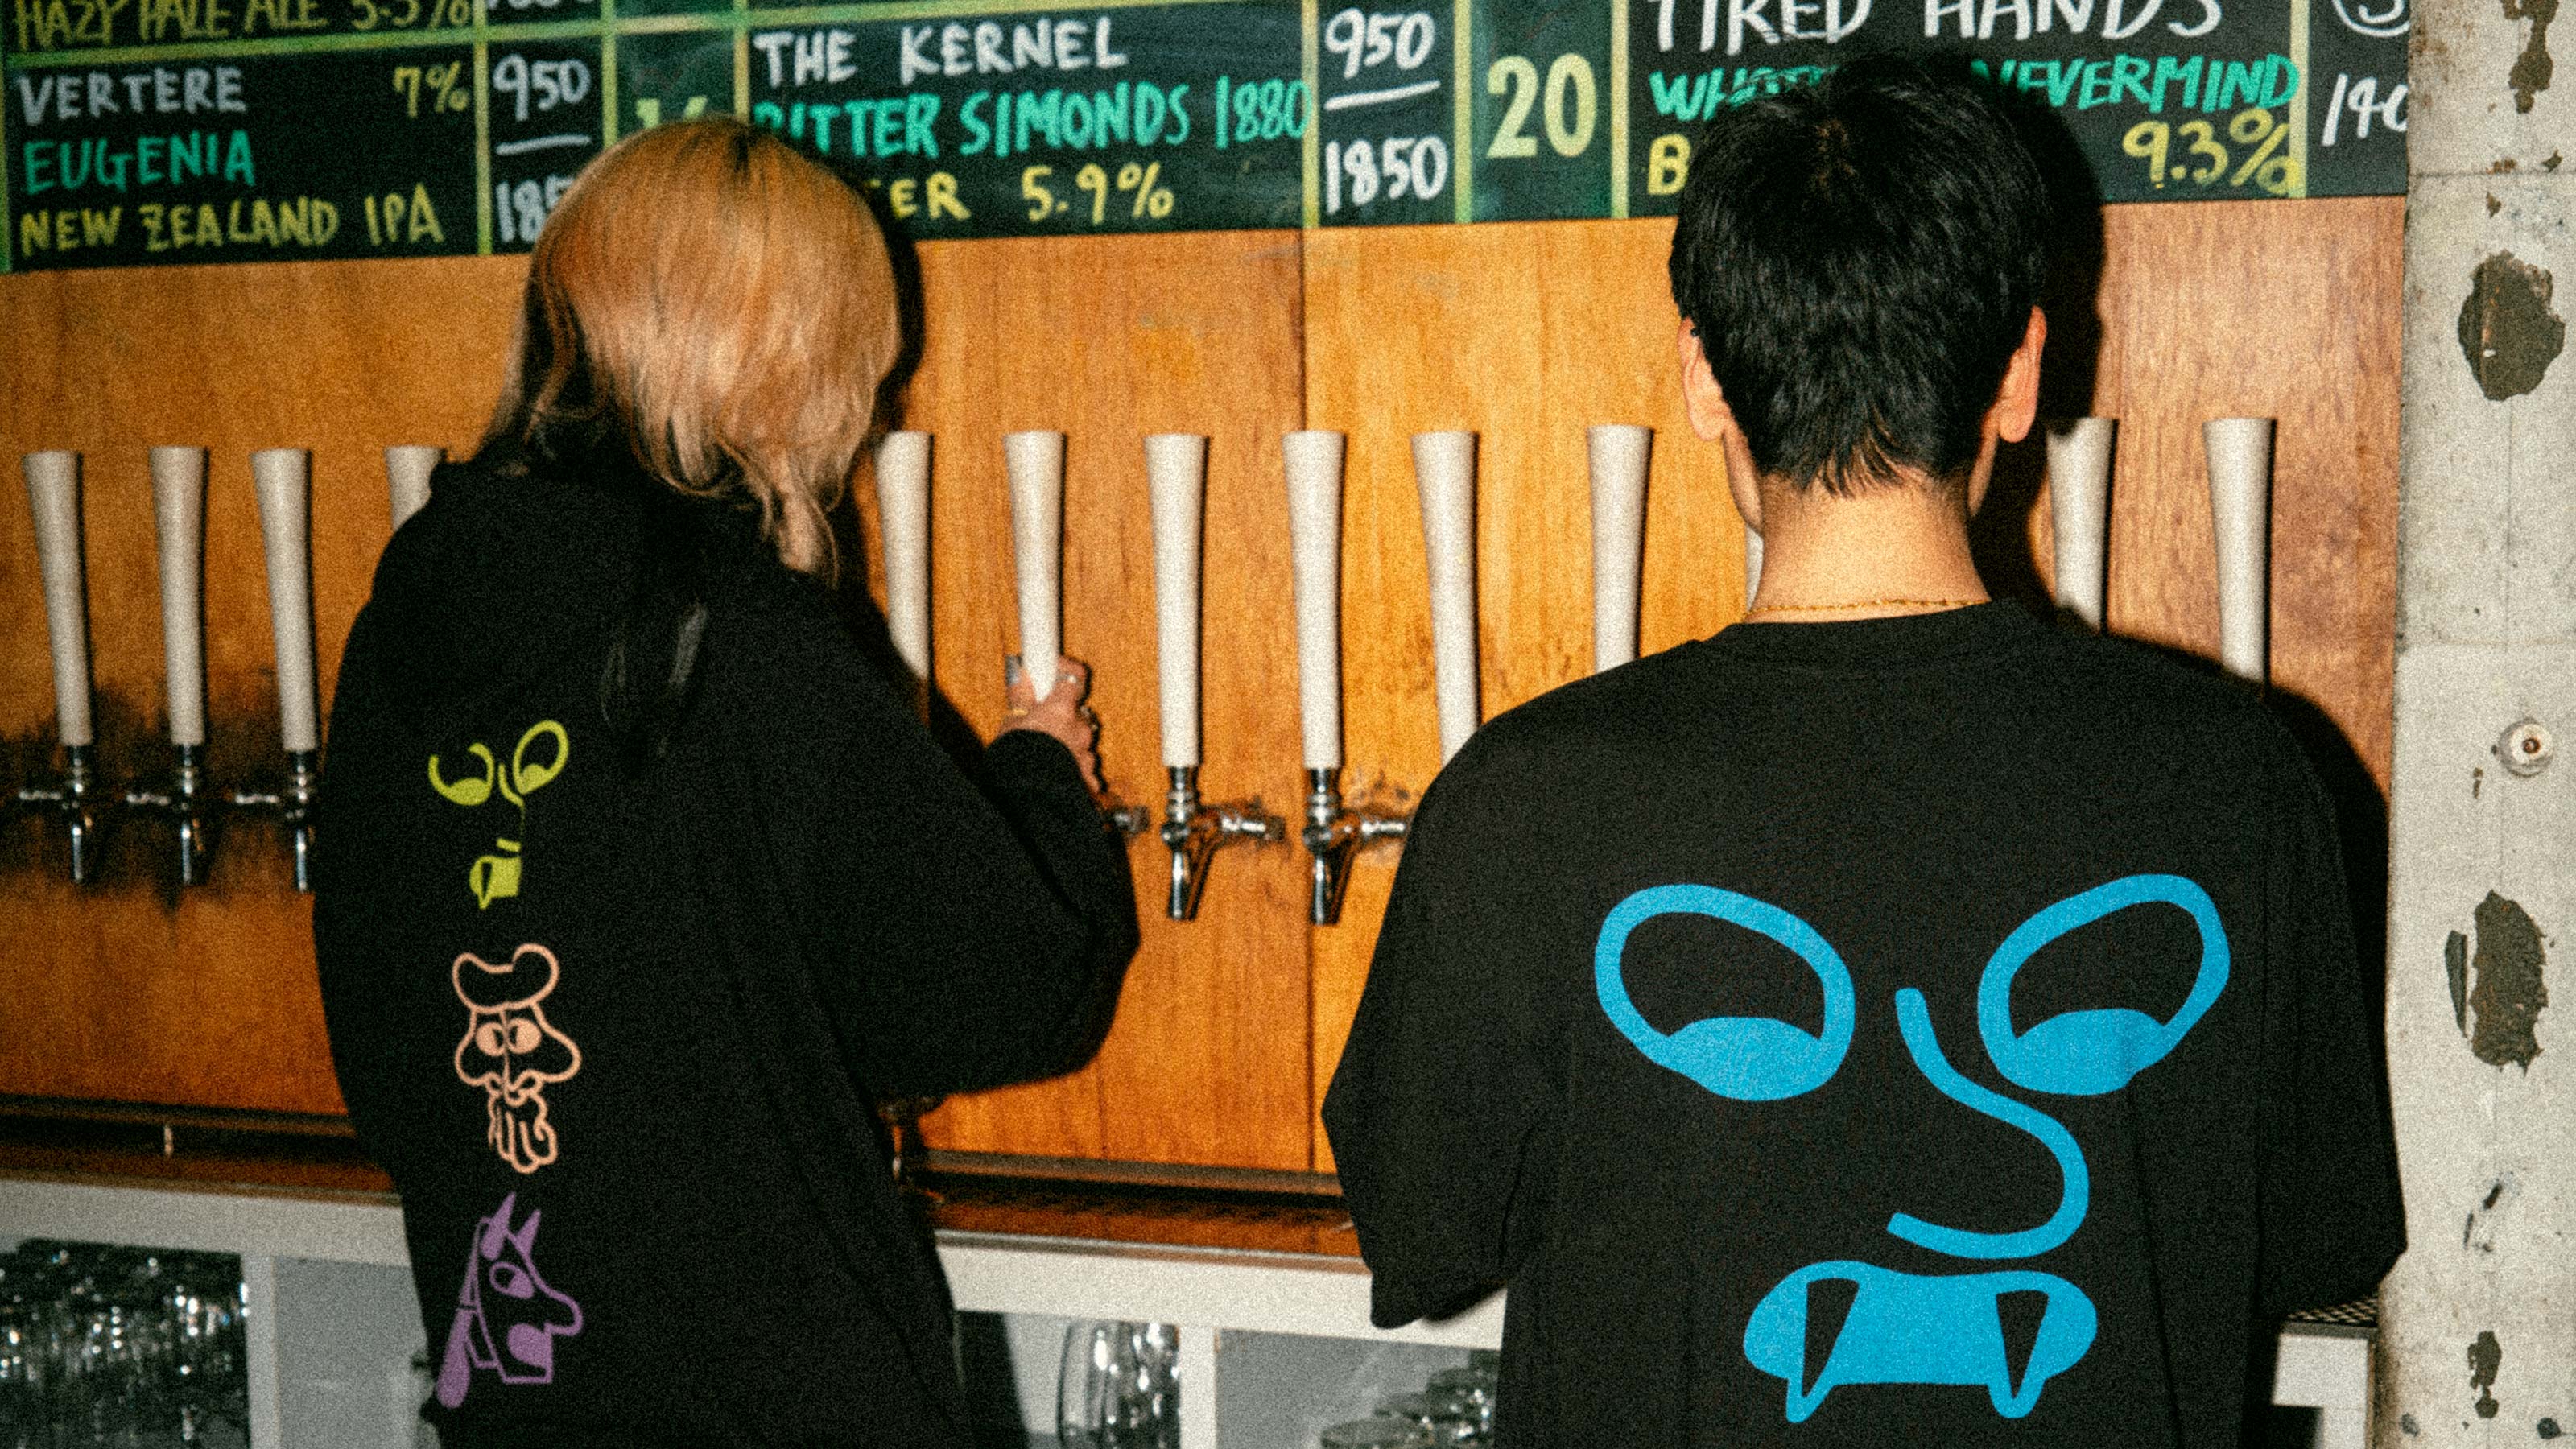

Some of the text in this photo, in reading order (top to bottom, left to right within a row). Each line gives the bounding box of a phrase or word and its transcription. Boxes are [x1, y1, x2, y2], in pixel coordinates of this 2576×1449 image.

[754, 16, 1127, 86] THE KERNEL
[1324, 6, 1436, 79] 950
[18, 62, 469, 126] VERTERE 7%
[493, 54, 591, 121] 950
[960, 81, 1190, 158] SIMONDS
[1216, 76, 1313, 150] 1880
[1486, 52, 1597, 159] 20
[23, 130, 256, 195] EUGENIA
[1324, 135, 1448, 214] 1850
[2122, 108, 2301, 196] 9.3%
[20, 183, 445, 257] NEW ZEALAND IPA
[1021, 162, 1175, 225] 5.9%
